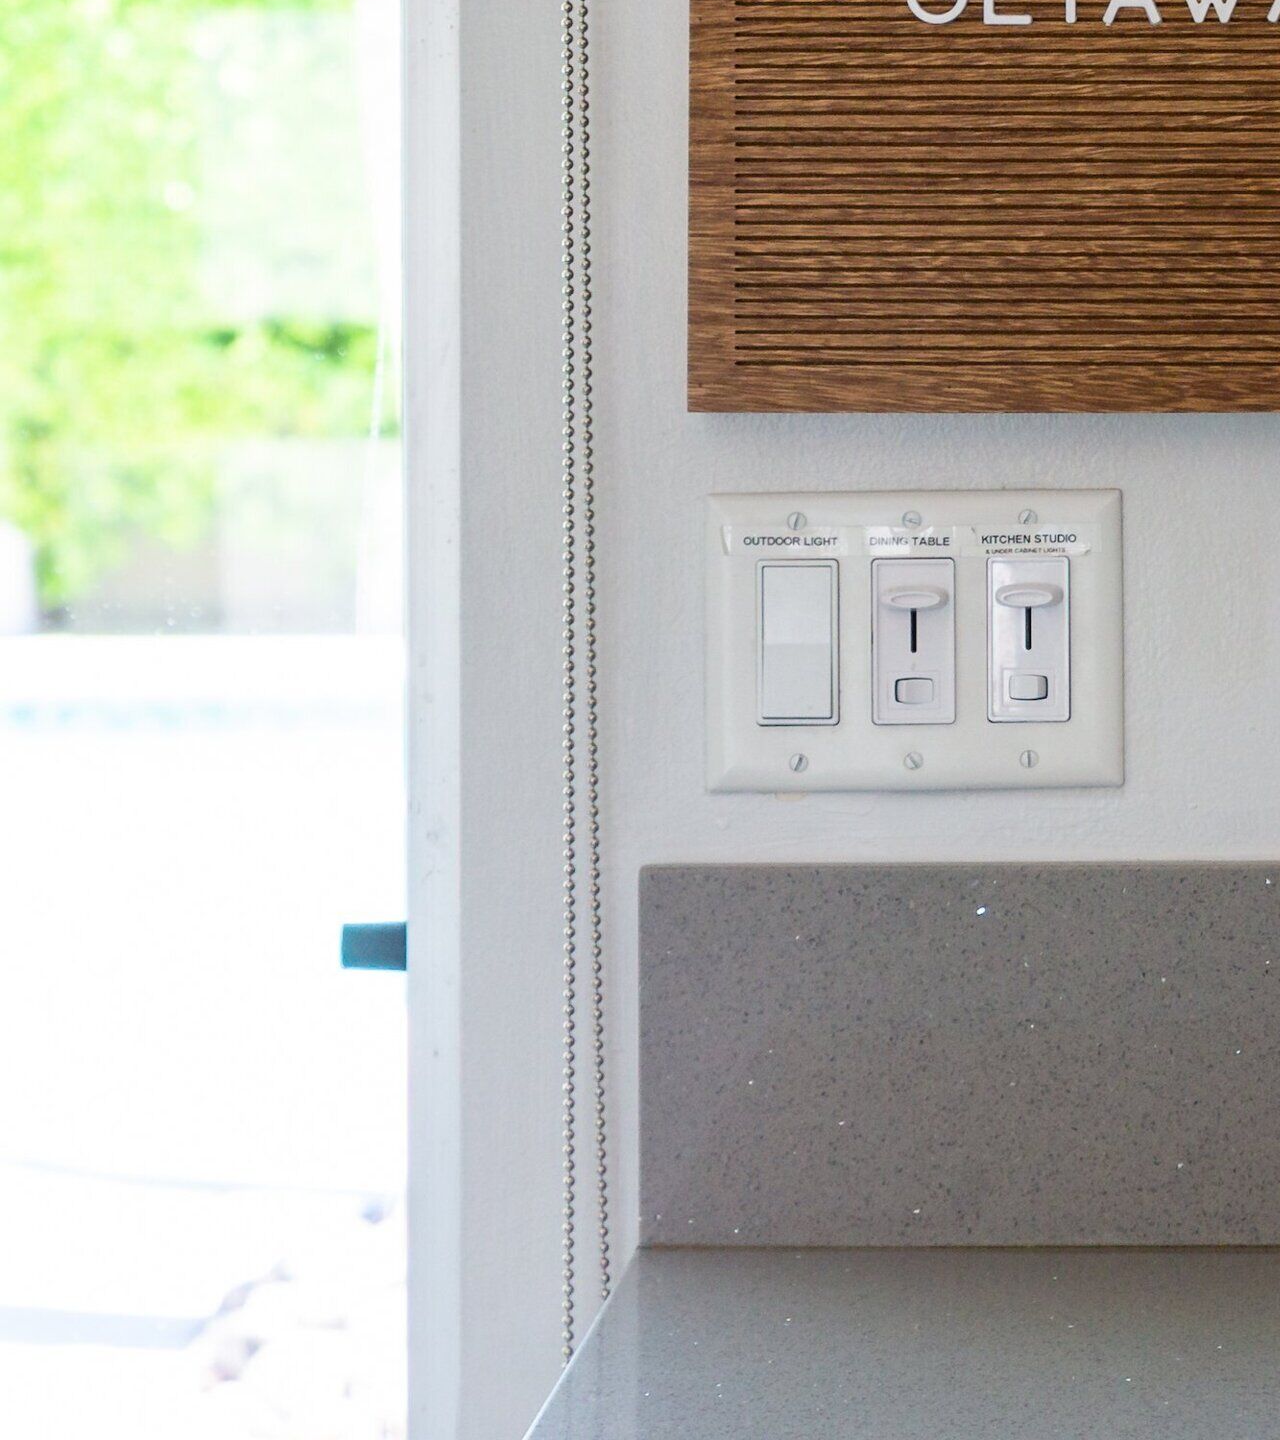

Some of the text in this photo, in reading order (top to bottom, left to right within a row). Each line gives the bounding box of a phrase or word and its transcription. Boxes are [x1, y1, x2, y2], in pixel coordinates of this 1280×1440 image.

[743, 536, 838, 546] OUTDOOR LIGHT
[869, 536, 950, 546] DINING TABLE
[981, 533, 1077, 544] KITCHEN STUDIO
